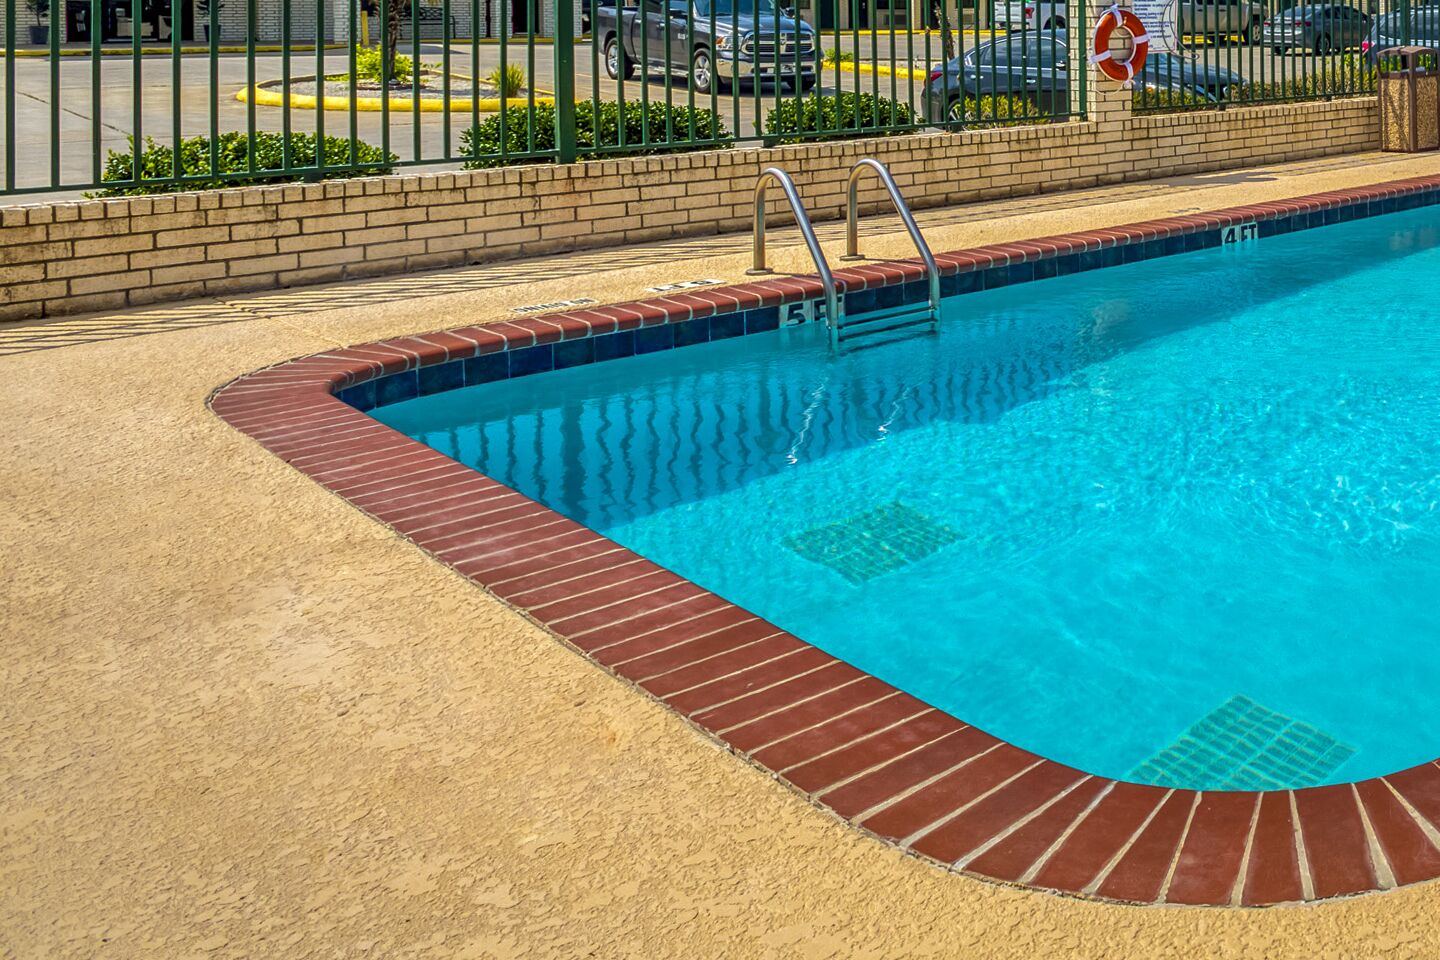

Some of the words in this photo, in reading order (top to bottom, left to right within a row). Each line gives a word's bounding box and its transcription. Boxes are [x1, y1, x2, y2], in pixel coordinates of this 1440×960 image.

[1225, 228, 1237, 244] 4
[1240, 224, 1256, 241] FT
[785, 302, 806, 326] 5
